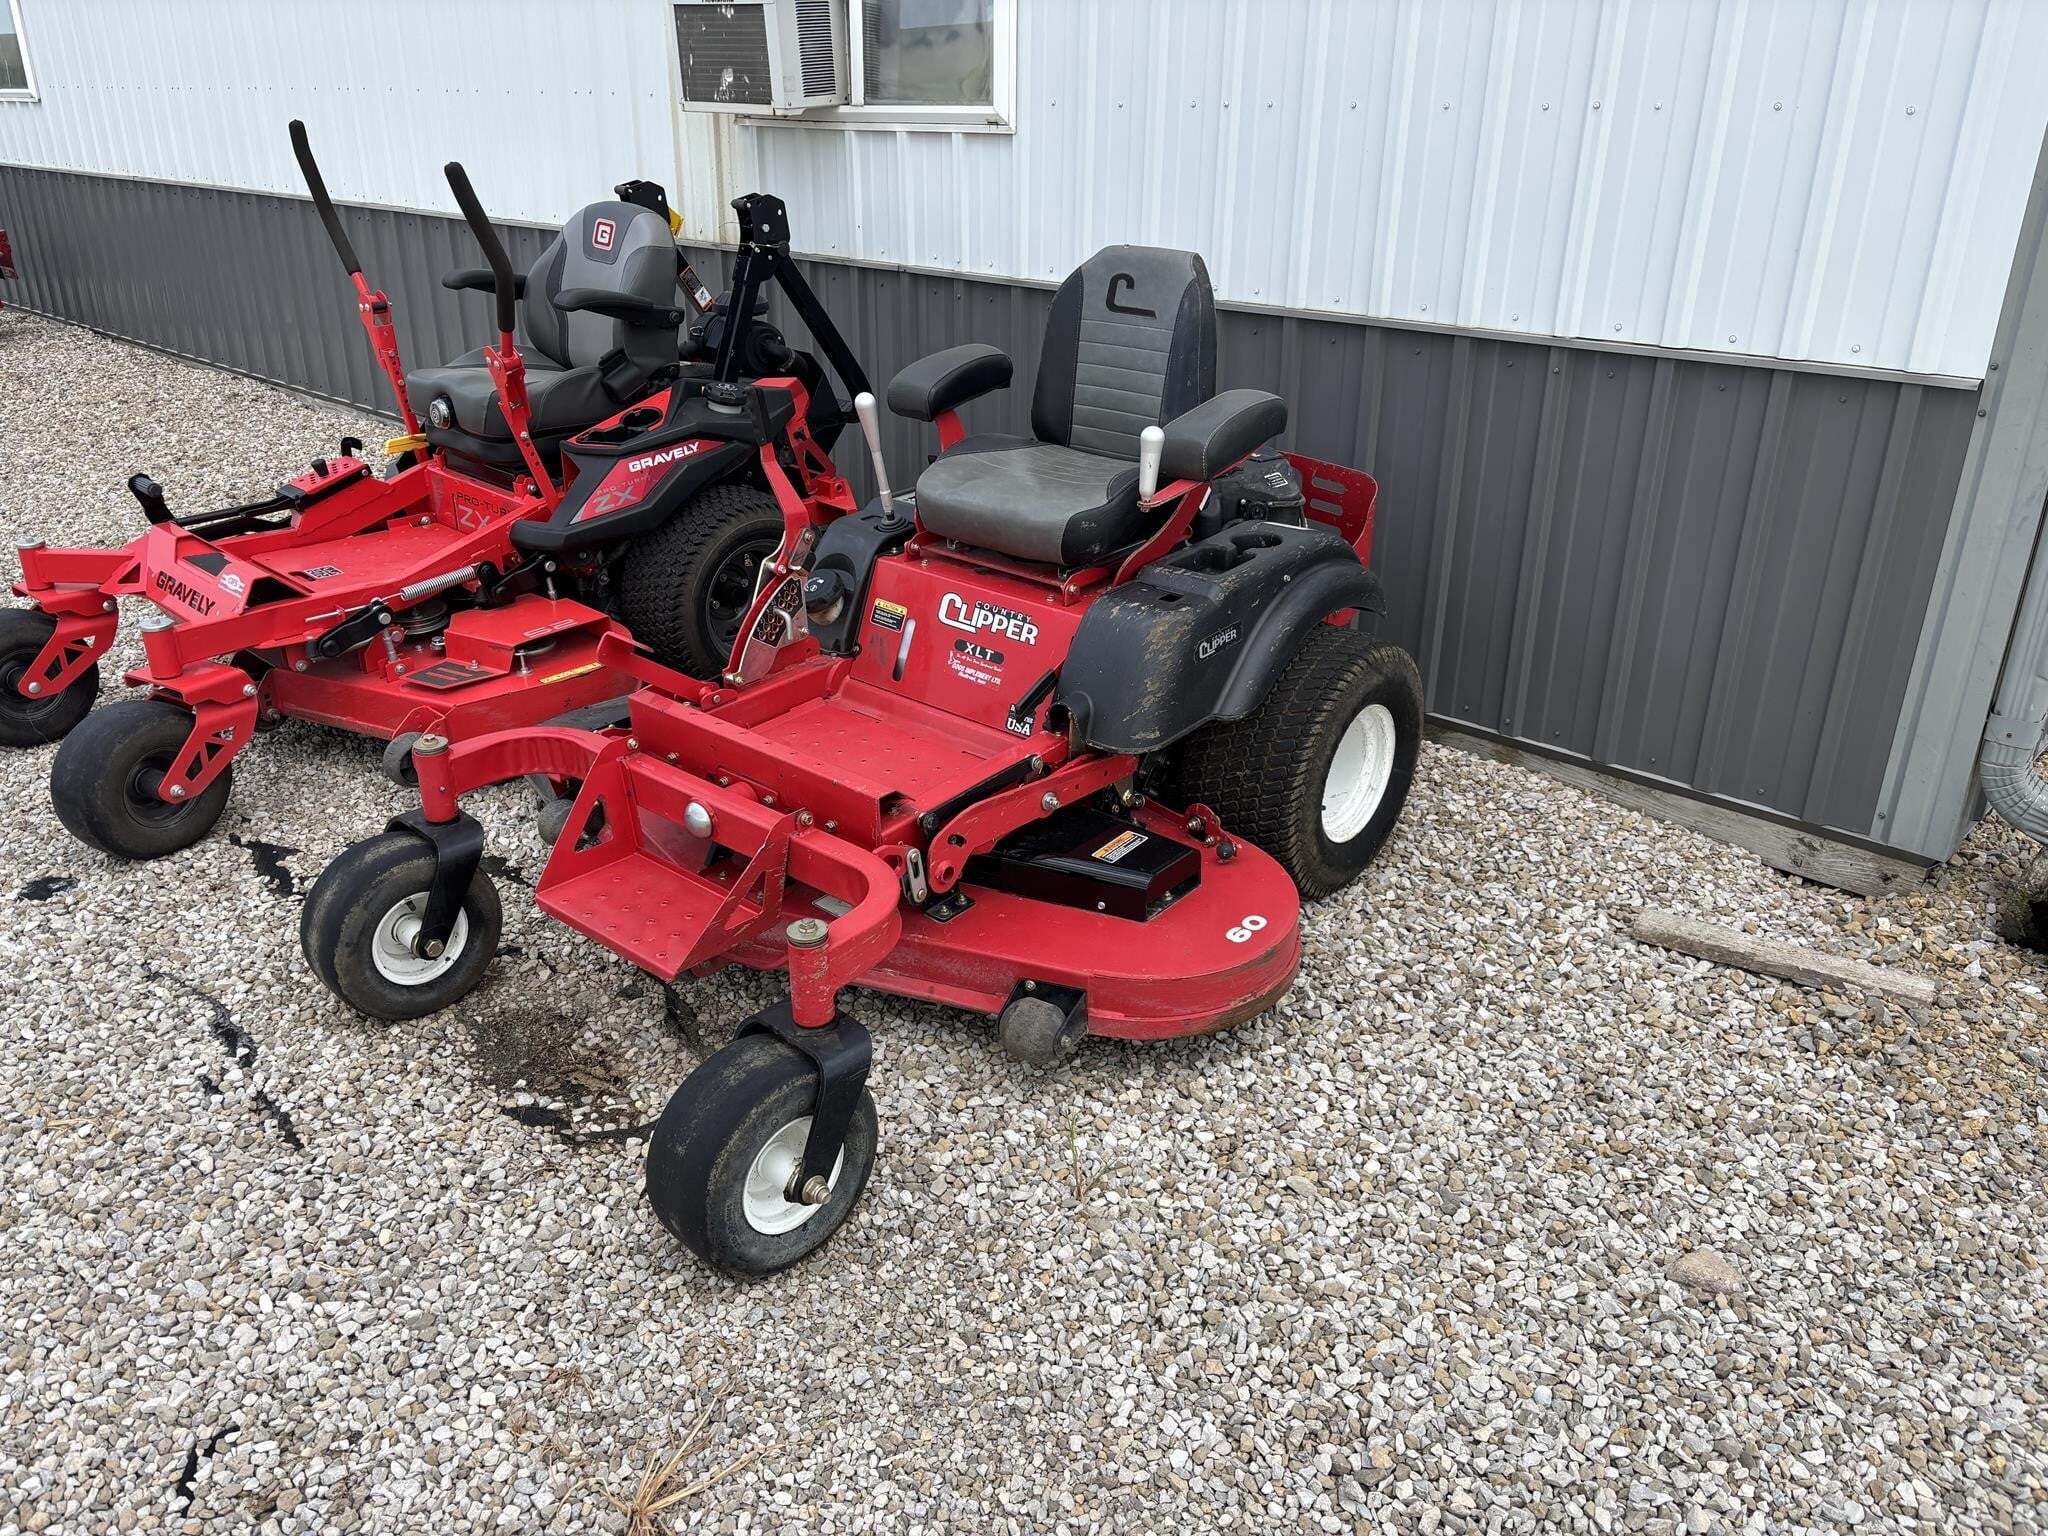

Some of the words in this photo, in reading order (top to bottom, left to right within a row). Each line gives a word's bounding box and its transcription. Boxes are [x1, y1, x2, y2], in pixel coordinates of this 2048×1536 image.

[628, 441, 699, 472] GRAVELY
[592, 486, 638, 513] ZX
[156, 570, 216, 617] GRAVELY
[938, 592, 1039, 645] CLIPPER
[975, 600, 1033, 623] COUNTRY
[964, 642, 995, 661] XLT
[1199, 628, 1237, 659] CLIPPER
[1225, 915, 1268, 943] 60
